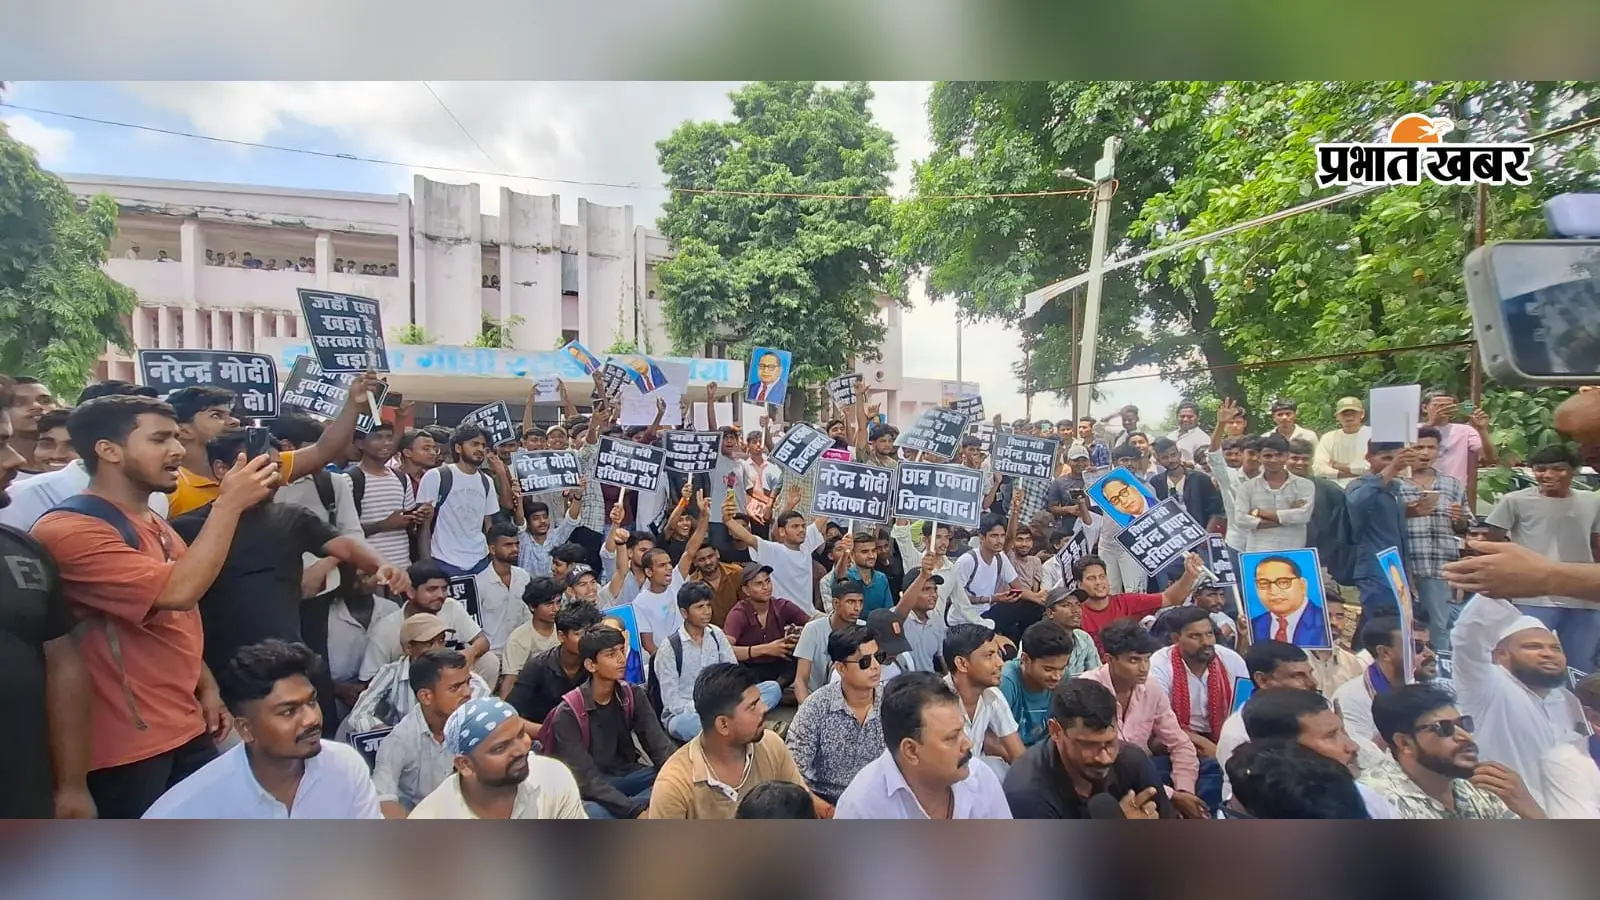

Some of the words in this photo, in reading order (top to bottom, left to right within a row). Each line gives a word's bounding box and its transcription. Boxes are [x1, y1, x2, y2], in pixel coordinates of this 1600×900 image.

[320, 315, 362, 334] खड़ा
[314, 336, 364, 348] सरकार
[148, 355, 212, 383] नरेन्द्र
[218, 356, 270, 383] मोदी
[334, 354, 366, 368] बड़ा
[242, 389, 273, 412] दो।
[516, 455, 547, 472] नरेन्द्र
[549, 453, 576, 468] मोदी
[630, 459, 660, 475] प्रधान
[1026, 452, 1052, 464] प्रधान
[520, 474, 562, 492] इस्तिफा
[820, 464, 857, 488] नरेन्द्र
[860, 470, 889, 494] मोदी
[902, 468, 932, 486] छात्र
[935, 470, 979, 492] एकता
[817, 491, 866, 514] इस्तिफा
[868, 497, 886, 518] दो।
[898, 489, 976, 520] जिन्दाबाद।
[1159, 512, 1190, 534] प्रधान
[1142, 534, 1188, 569] इस्तिफा
